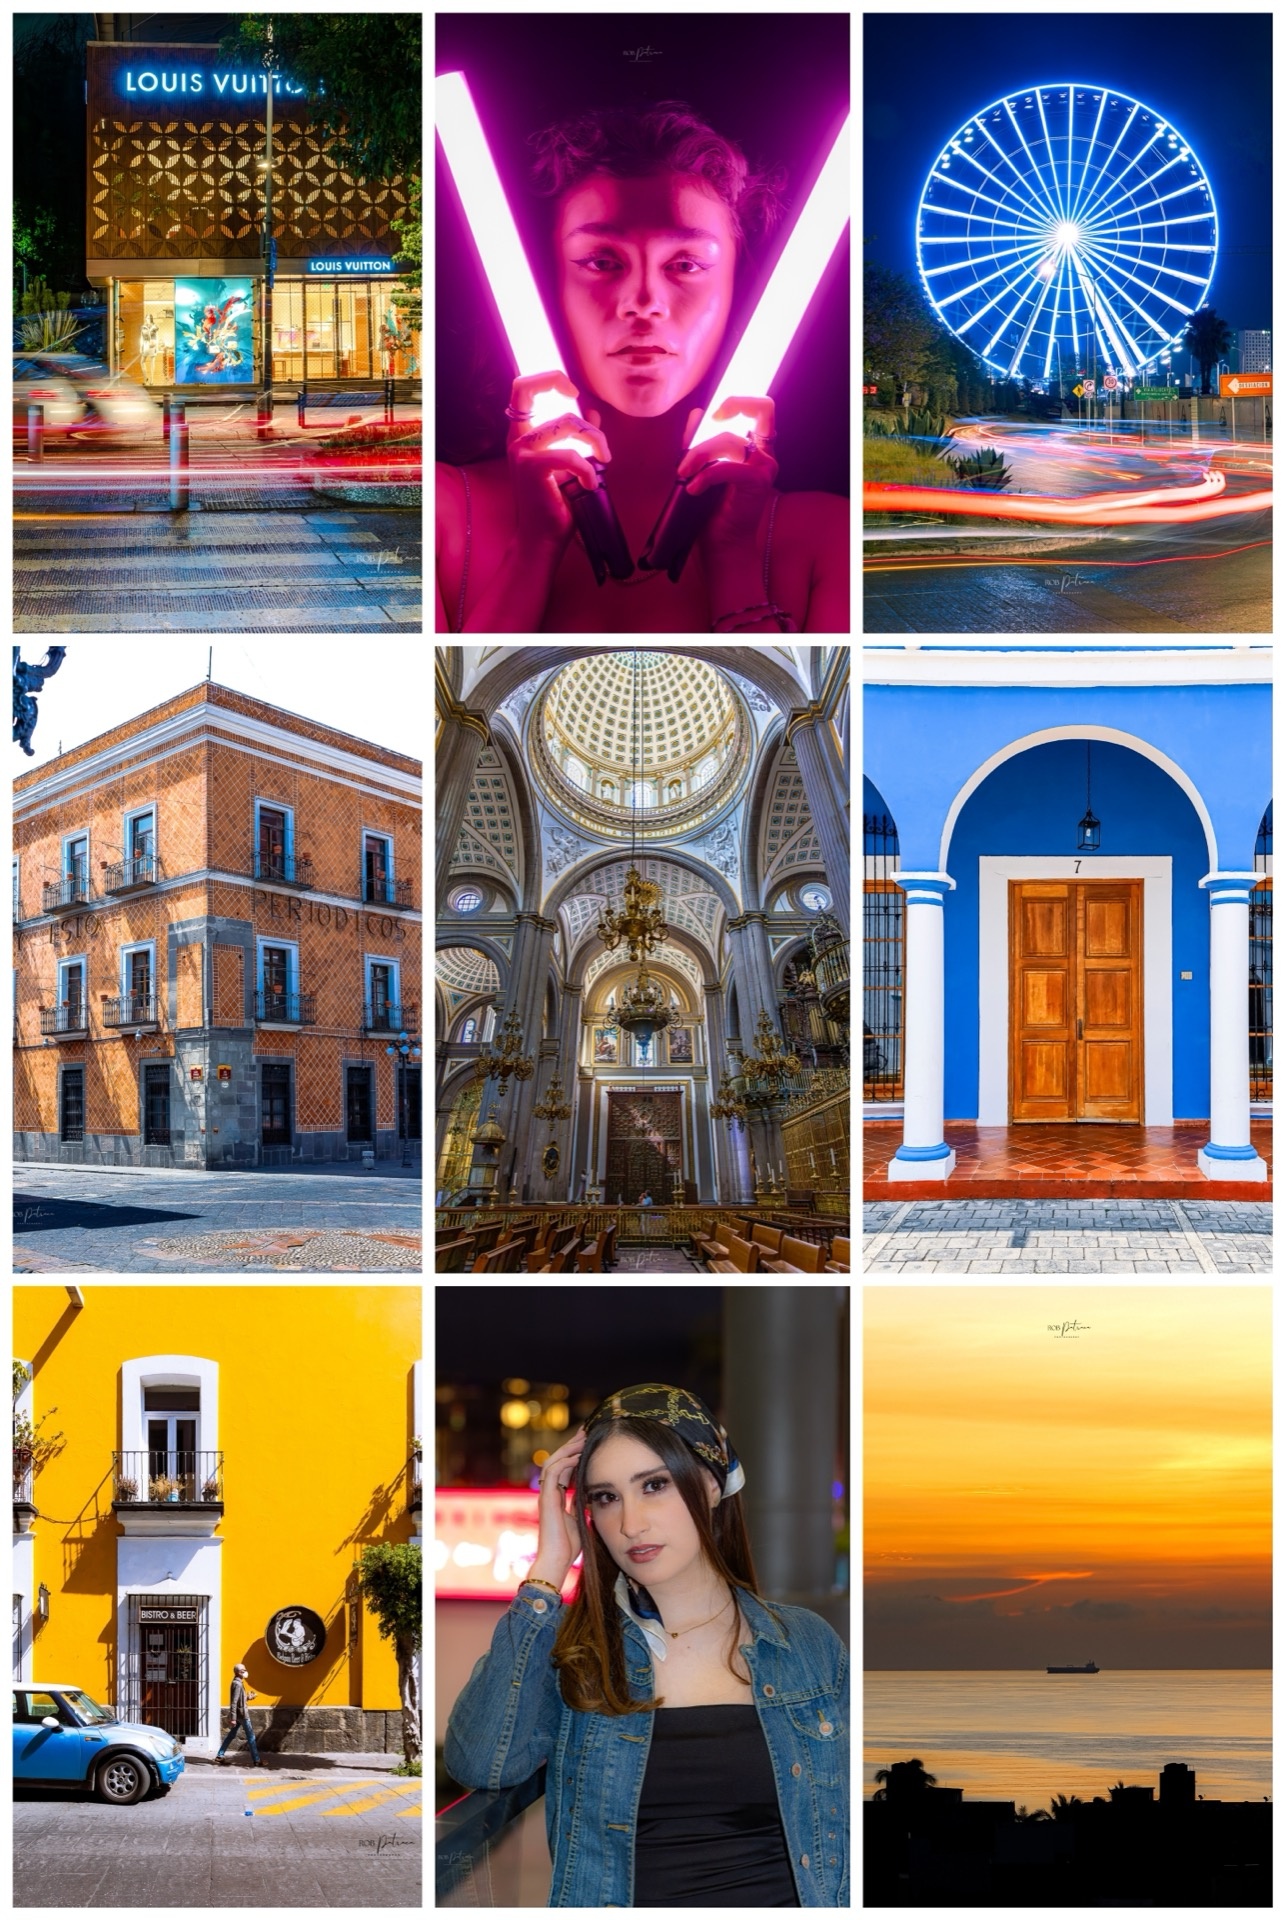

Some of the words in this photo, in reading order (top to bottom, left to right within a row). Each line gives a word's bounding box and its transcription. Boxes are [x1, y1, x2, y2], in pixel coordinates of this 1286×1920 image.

[126, 72, 203, 92] LOUIS
[213, 73, 325, 94] VUITTO
[311, 261, 342, 271] LOUIS
[344, 261, 391, 271] VUITTON
[1074, 860, 1082, 874] 7
[253, 891, 407, 941] PERIODICOS
[141, 1610, 169, 1619] BISTRO
[176, 1611, 197, 1619] BEER
